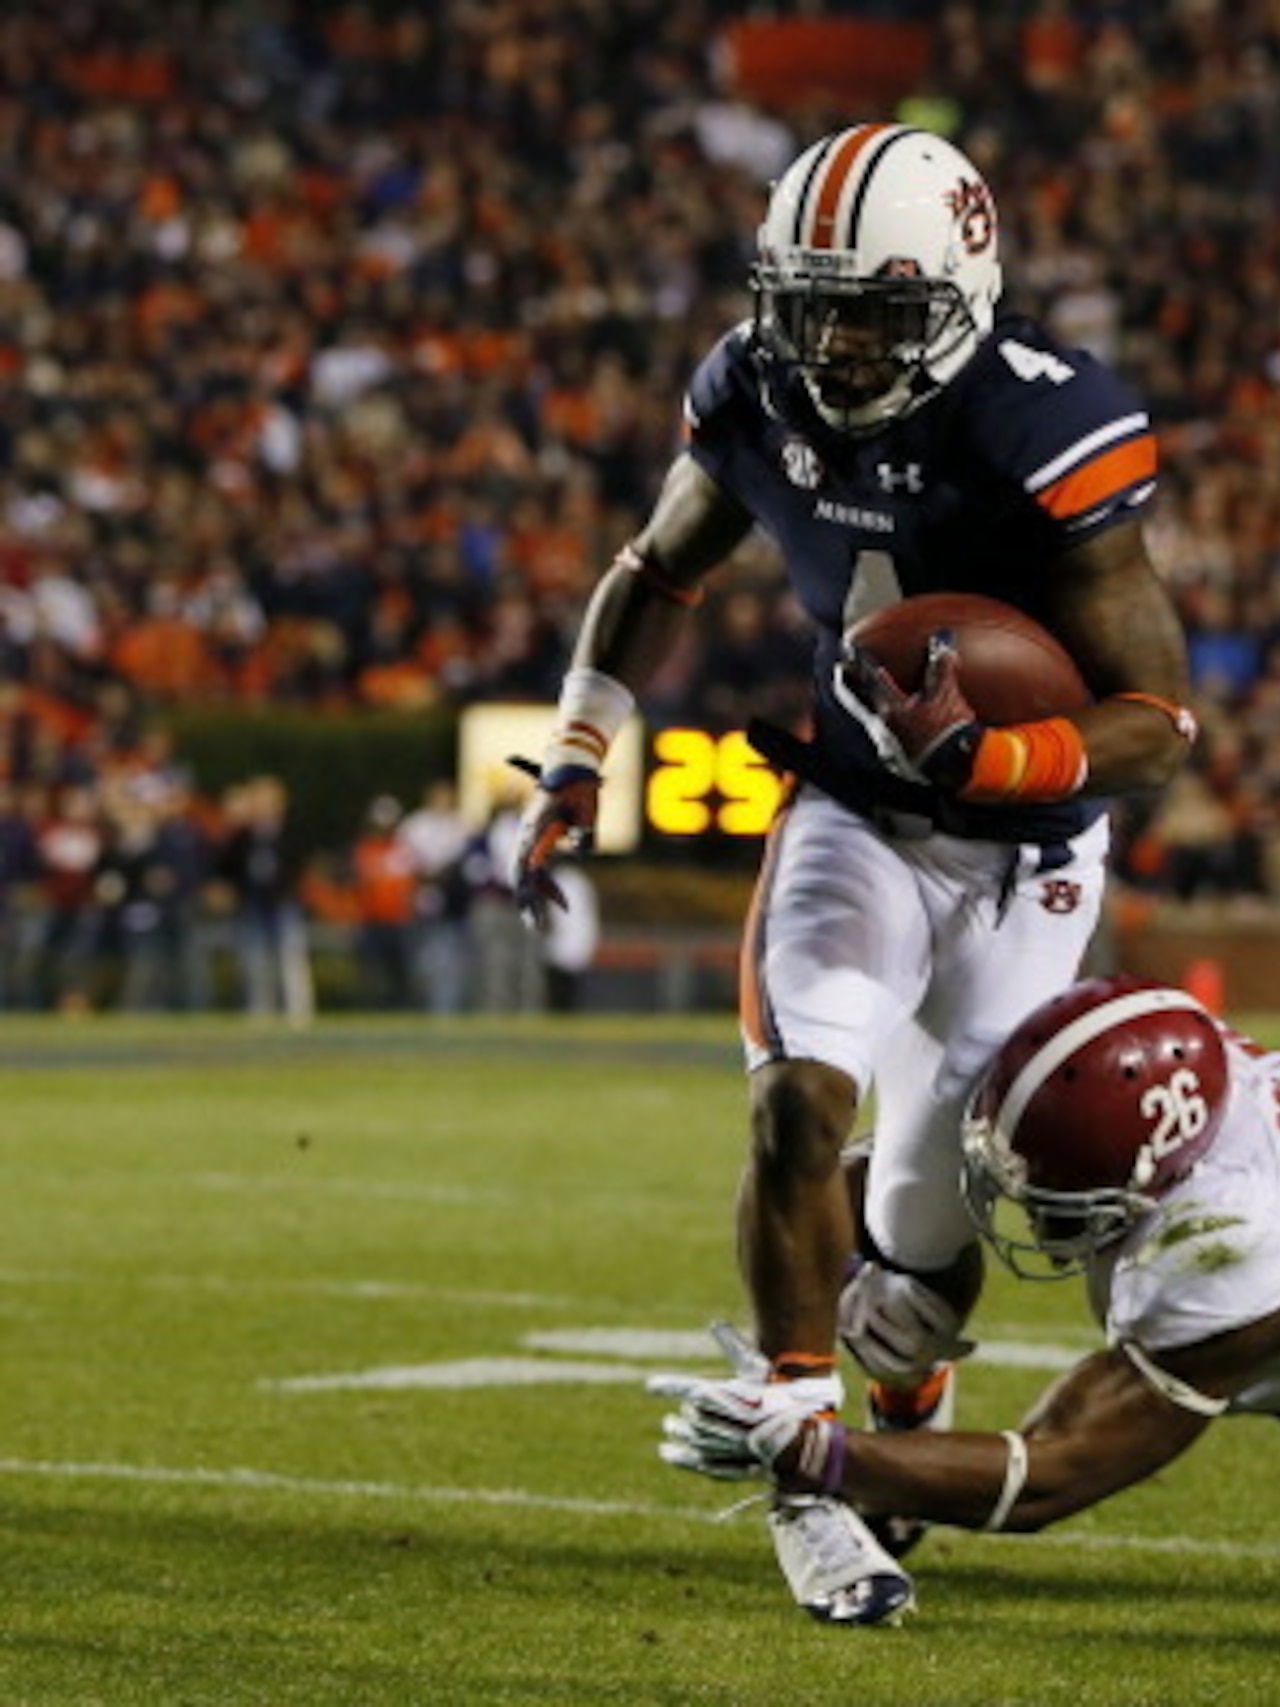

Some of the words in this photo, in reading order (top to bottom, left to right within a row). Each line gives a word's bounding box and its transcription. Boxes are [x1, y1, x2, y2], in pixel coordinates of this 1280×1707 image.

[998, 339, 1075, 384] 4
[647, 729, 783, 834] 25
[1140, 1067, 1208, 1160] 26
